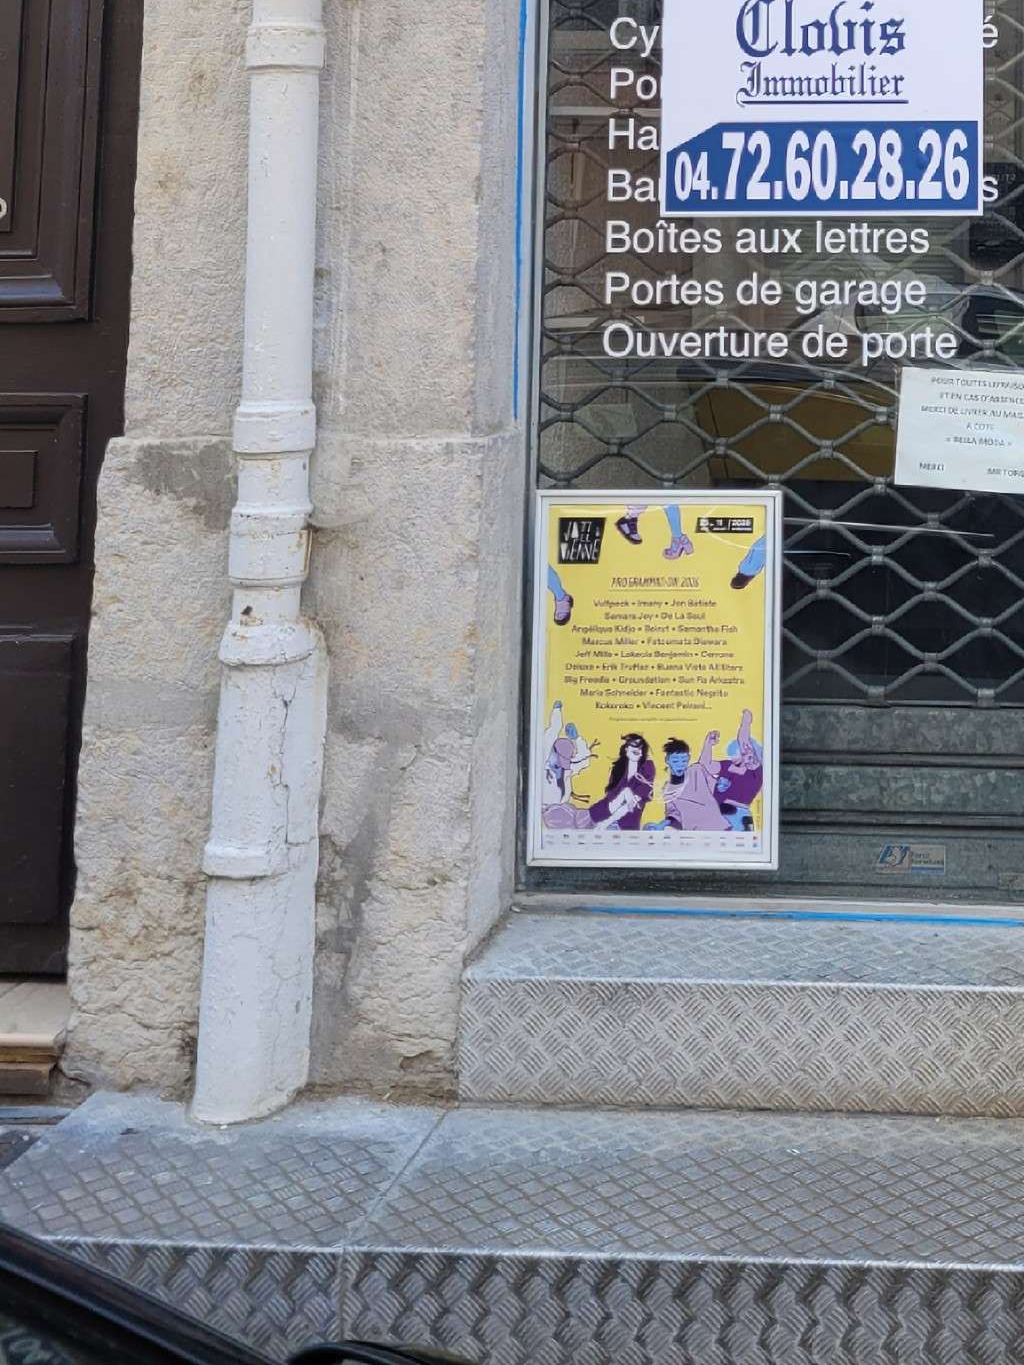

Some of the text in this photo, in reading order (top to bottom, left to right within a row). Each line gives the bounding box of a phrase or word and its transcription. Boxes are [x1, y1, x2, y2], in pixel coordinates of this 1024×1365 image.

[736, 61, 906, 100] Immobilier
[674, 129, 969, 201] 04.72.60.28.26
[605, 219, 929, 254] Boîtes aux lettres
[604, 272, 927, 314] Portes de garage
[602, 323, 958, 366] Ouverture de porte
